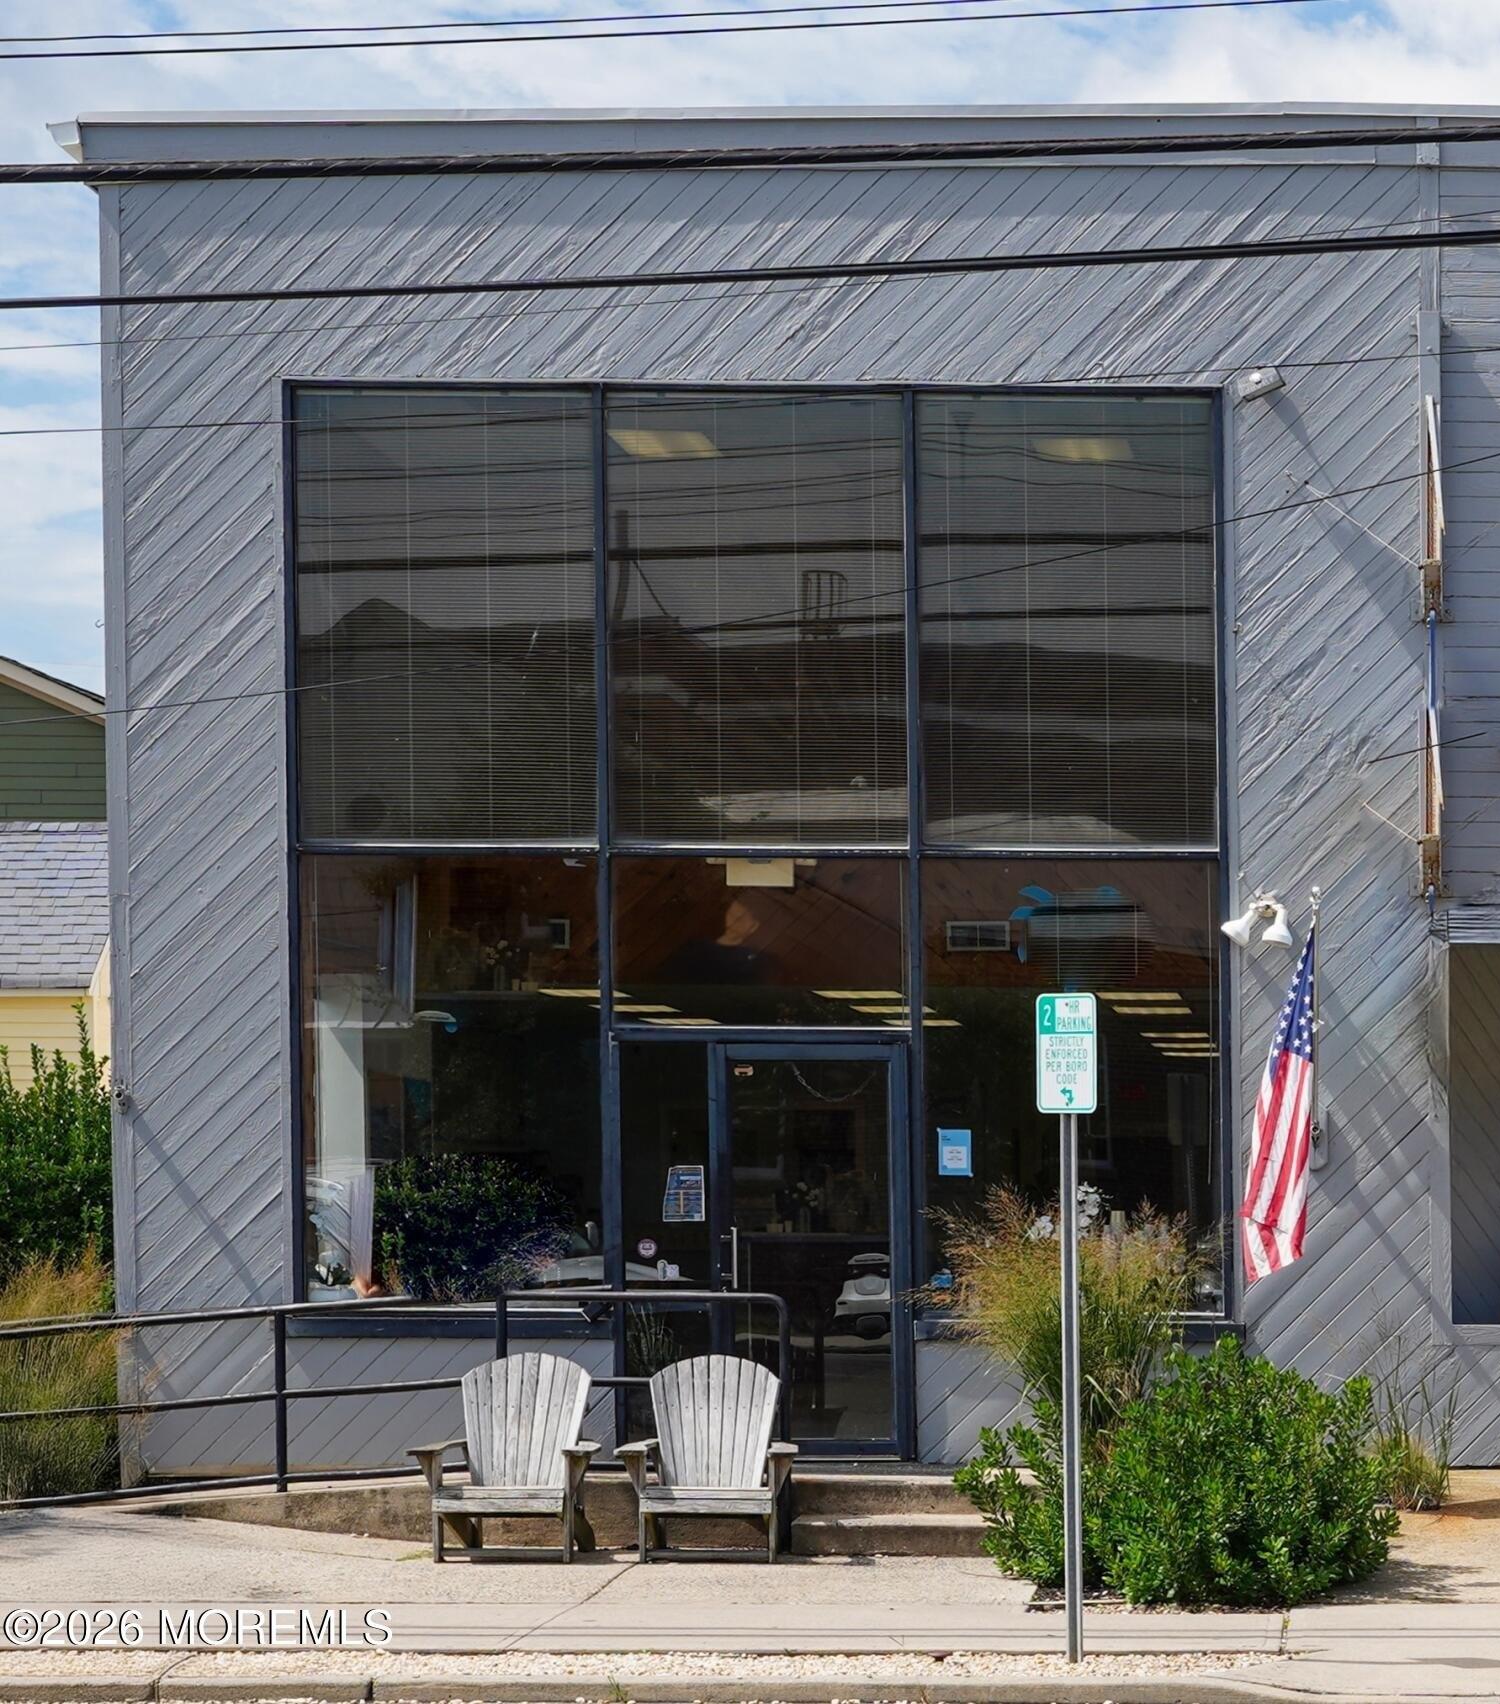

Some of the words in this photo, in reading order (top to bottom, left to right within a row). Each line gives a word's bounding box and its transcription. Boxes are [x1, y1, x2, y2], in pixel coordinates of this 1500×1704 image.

[1043, 1004, 1052, 1026] 2
[1069, 1001, 1080, 1013] HR
[1057, 1016, 1092, 1030] PARKING
[1049, 1036, 1085, 1047] STRICTLY
[1045, 1049, 1088, 1060] ENFORCED
[1046, 1061, 1062, 1072] PER
[1066, 1061, 1088, 1072] BORO
[1056, 1073, 1078, 1085] CODE
